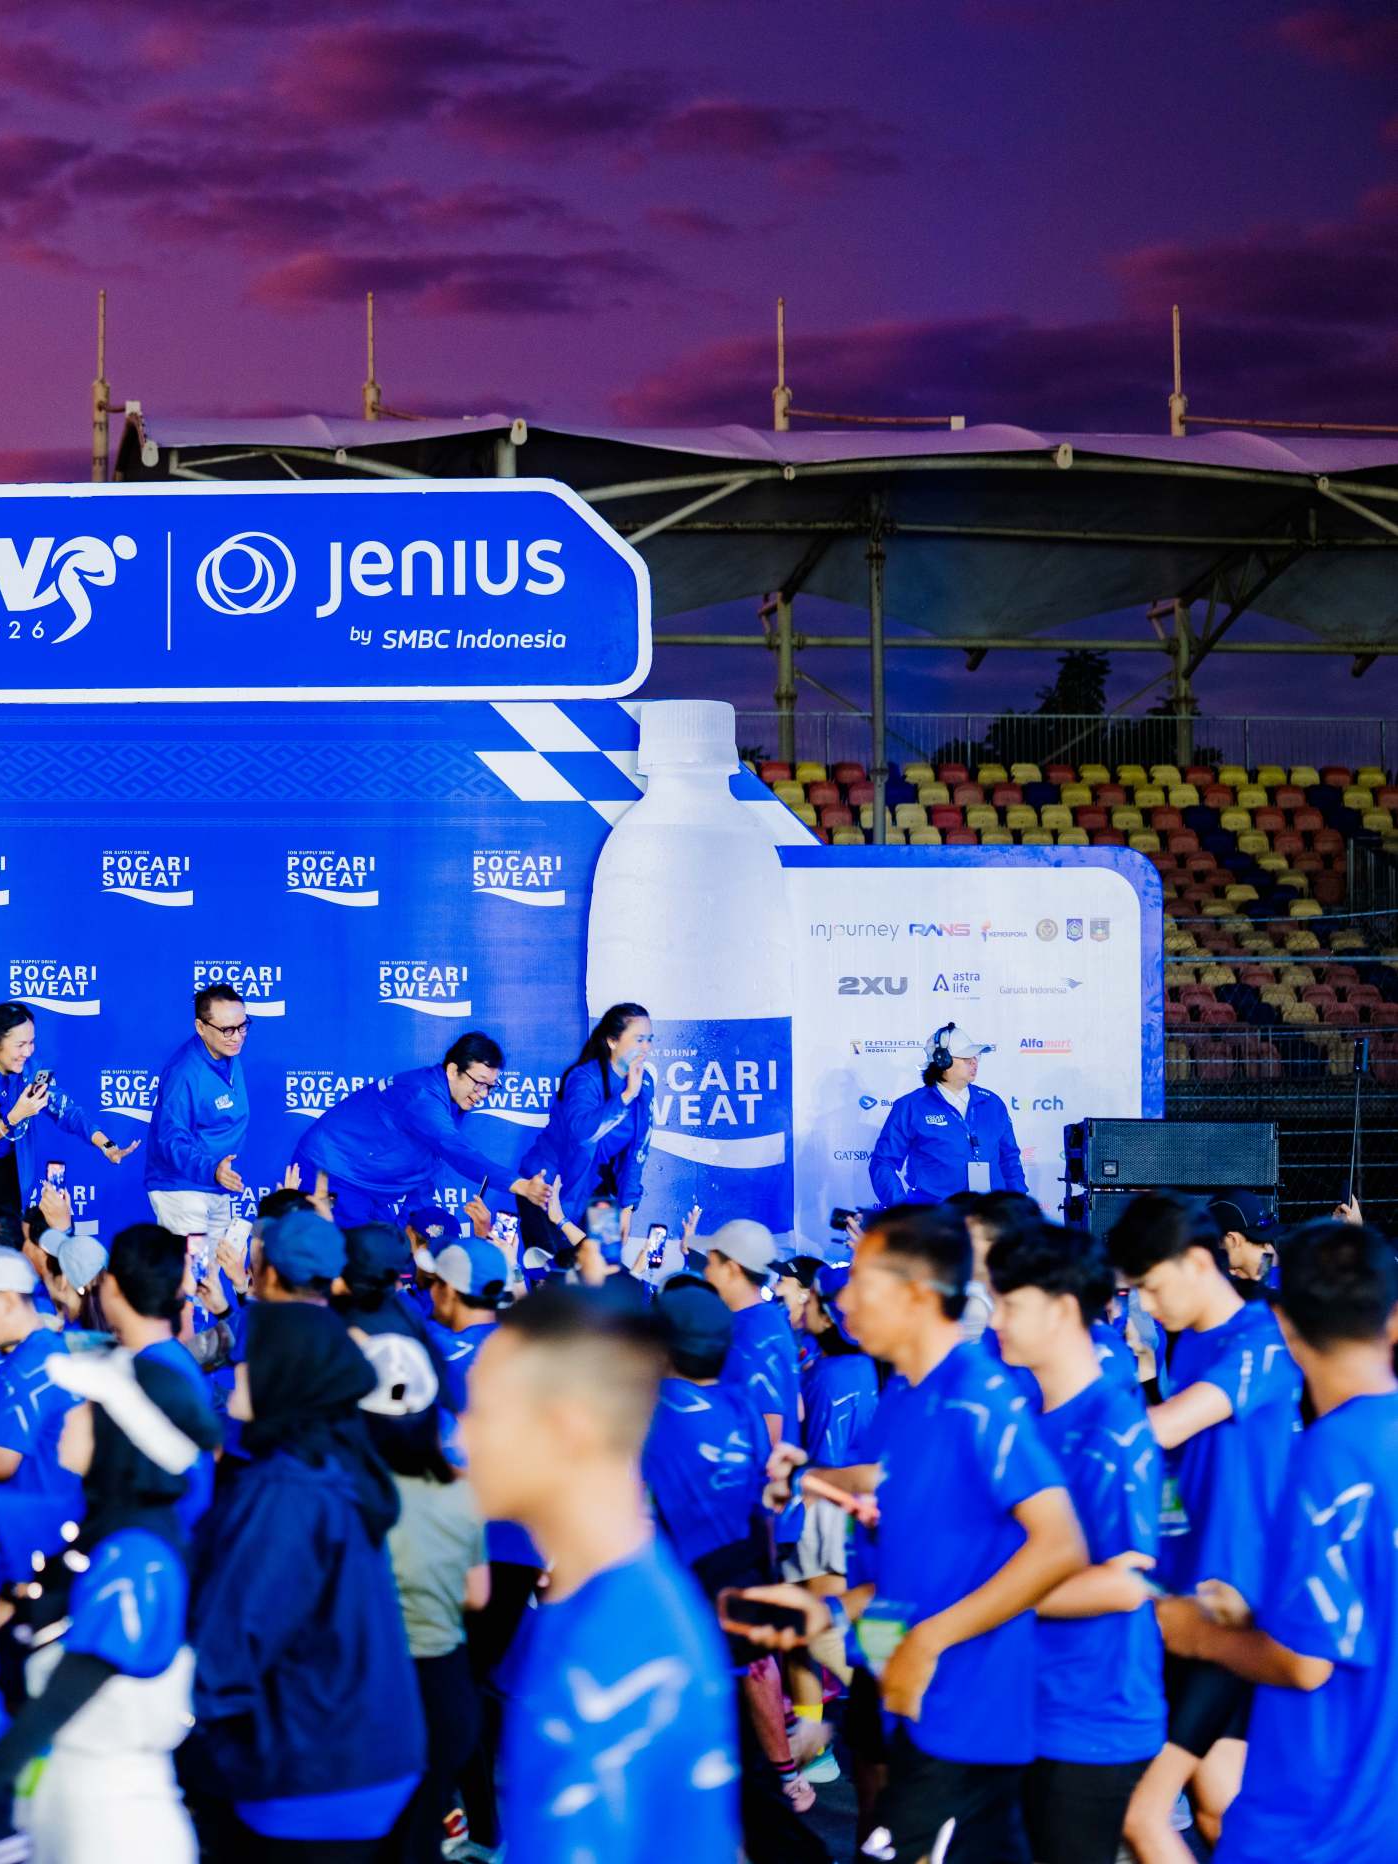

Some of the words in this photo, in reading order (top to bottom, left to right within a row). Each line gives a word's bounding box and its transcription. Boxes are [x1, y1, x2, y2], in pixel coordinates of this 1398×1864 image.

[350, 626, 372, 646] by
[382, 629, 451, 649] SMBC
[456, 629, 566, 649] Indonesia
[103, 856, 189, 871] POCARI
[288, 857, 374, 871] POCARI
[474, 856, 561, 871] POCARI
[103, 872, 181, 886] SWEAT
[288, 872, 366, 886] SWEAT
[474, 872, 553, 886] SWEAT
[909, 923, 971, 937] RANS
[10, 966, 96, 980] POCARI
[195, 966, 281, 981] POCARI
[380, 967, 467, 981] POCARI
[953, 972, 980, 982] astra
[10, 981, 88, 995] SWEAT
[194, 982, 273, 996] SEAT
[380, 982, 459, 997] SWEAT
[838, 976, 908, 995] 2XU
[953, 983, 970, 993] life
[1020, 1038, 1073, 1048] Alfamart
[664, 1049, 698, 1057] DRINK
[646, 1060, 778, 1091] CARI
[101, 1076, 159, 1092] POCA
[501, 1077, 561, 1092] CARI
[652, 1094, 763, 1126] EAT
